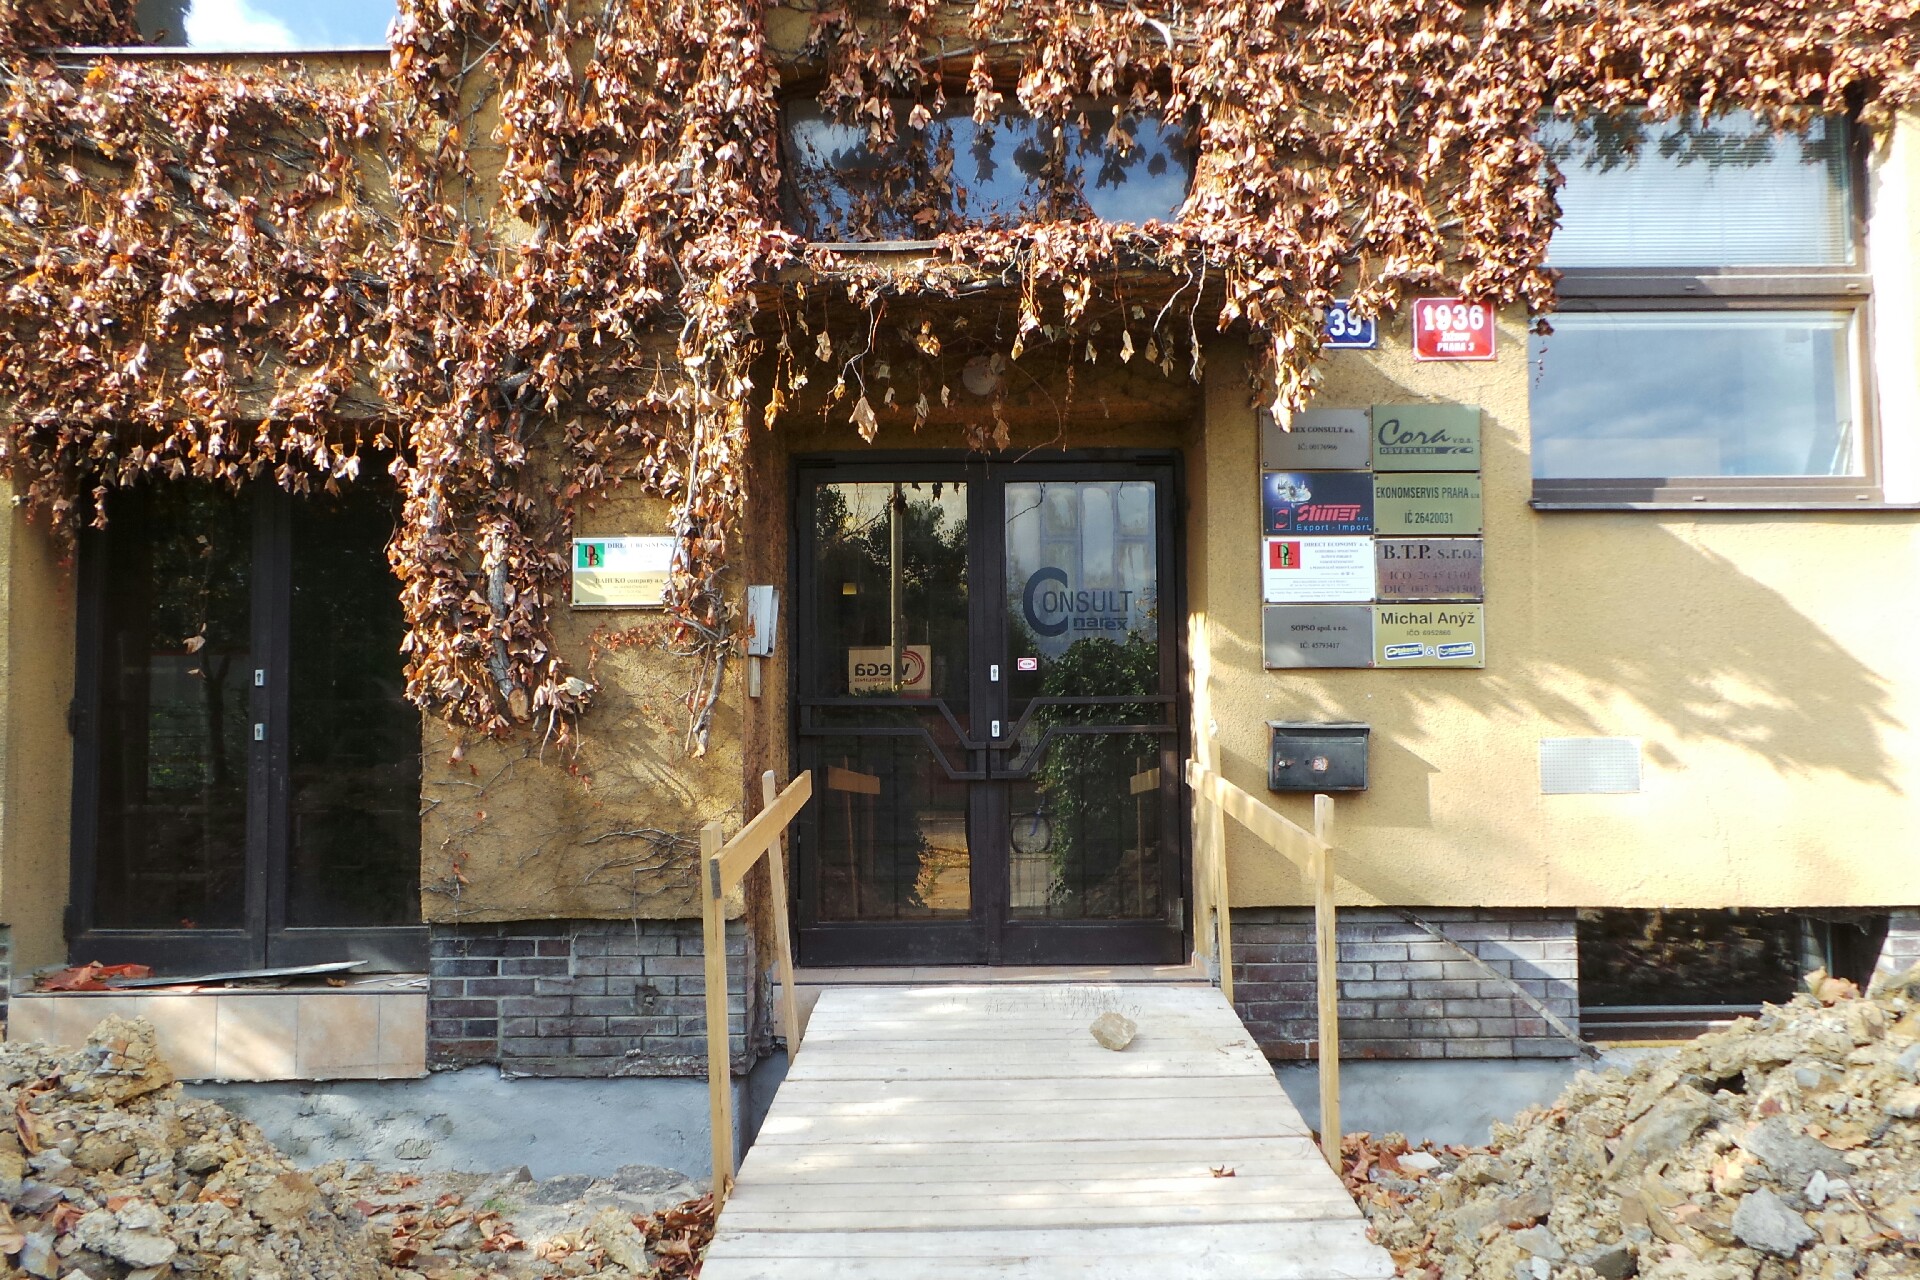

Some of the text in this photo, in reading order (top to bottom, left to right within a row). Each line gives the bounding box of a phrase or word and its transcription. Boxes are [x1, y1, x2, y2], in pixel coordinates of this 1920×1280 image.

[1329, 308, 1362, 337] 39
[1422, 304, 1484, 331] 1936
[1437, 342, 1475, 352] PRAHA 3
[1378, 418, 1451, 446] Cora
[1376, 487, 1439, 498] EKONOMSERVIS
[1441, 487, 1469, 498] PRAHA
[1404, 509, 1453, 524] IČ 26420031
[1296, 524, 1329, 532] Export
[1338, 524, 1370, 532] Import
[1383, 544, 1477, 559] B.T.P. s.r.o.
[1023, 566, 1133, 638] CONSULT
[1074, 617, 1128, 631] narex
[1381, 611, 1475, 627] Michal Anýž
[1425, 646, 1435, 656] &
